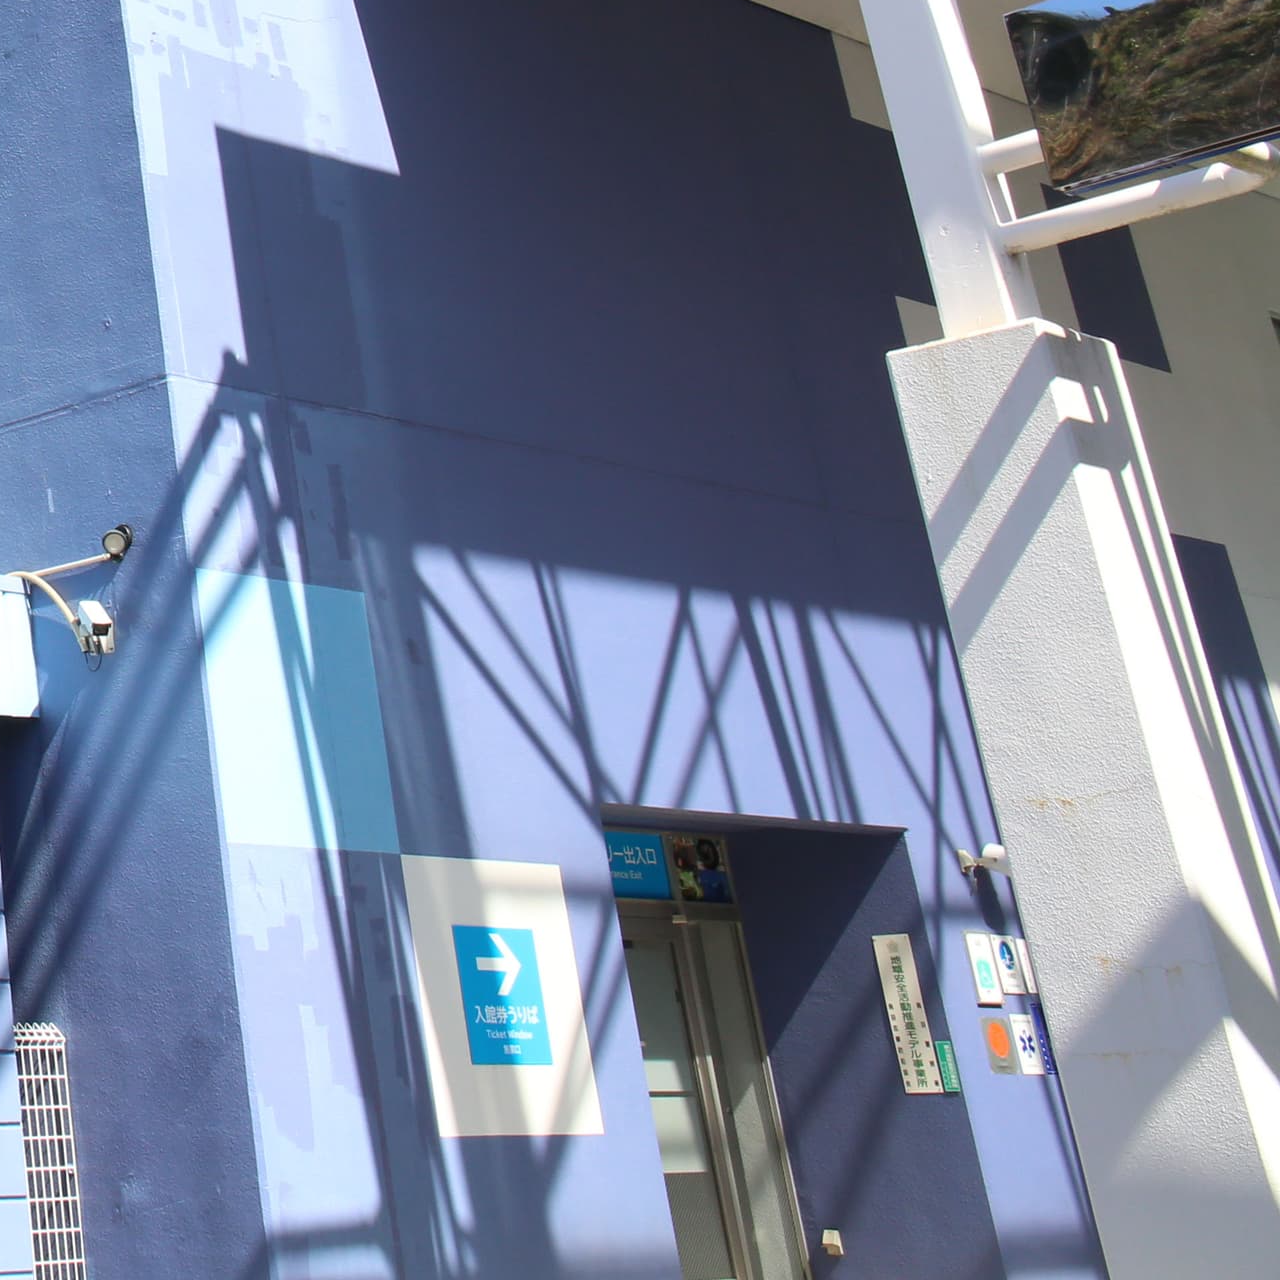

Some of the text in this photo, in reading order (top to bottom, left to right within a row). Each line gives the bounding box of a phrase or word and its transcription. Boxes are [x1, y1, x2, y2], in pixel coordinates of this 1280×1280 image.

[474, 1005, 540, 1024] 入館券うりば
[486, 1029, 507, 1039] Ticket
